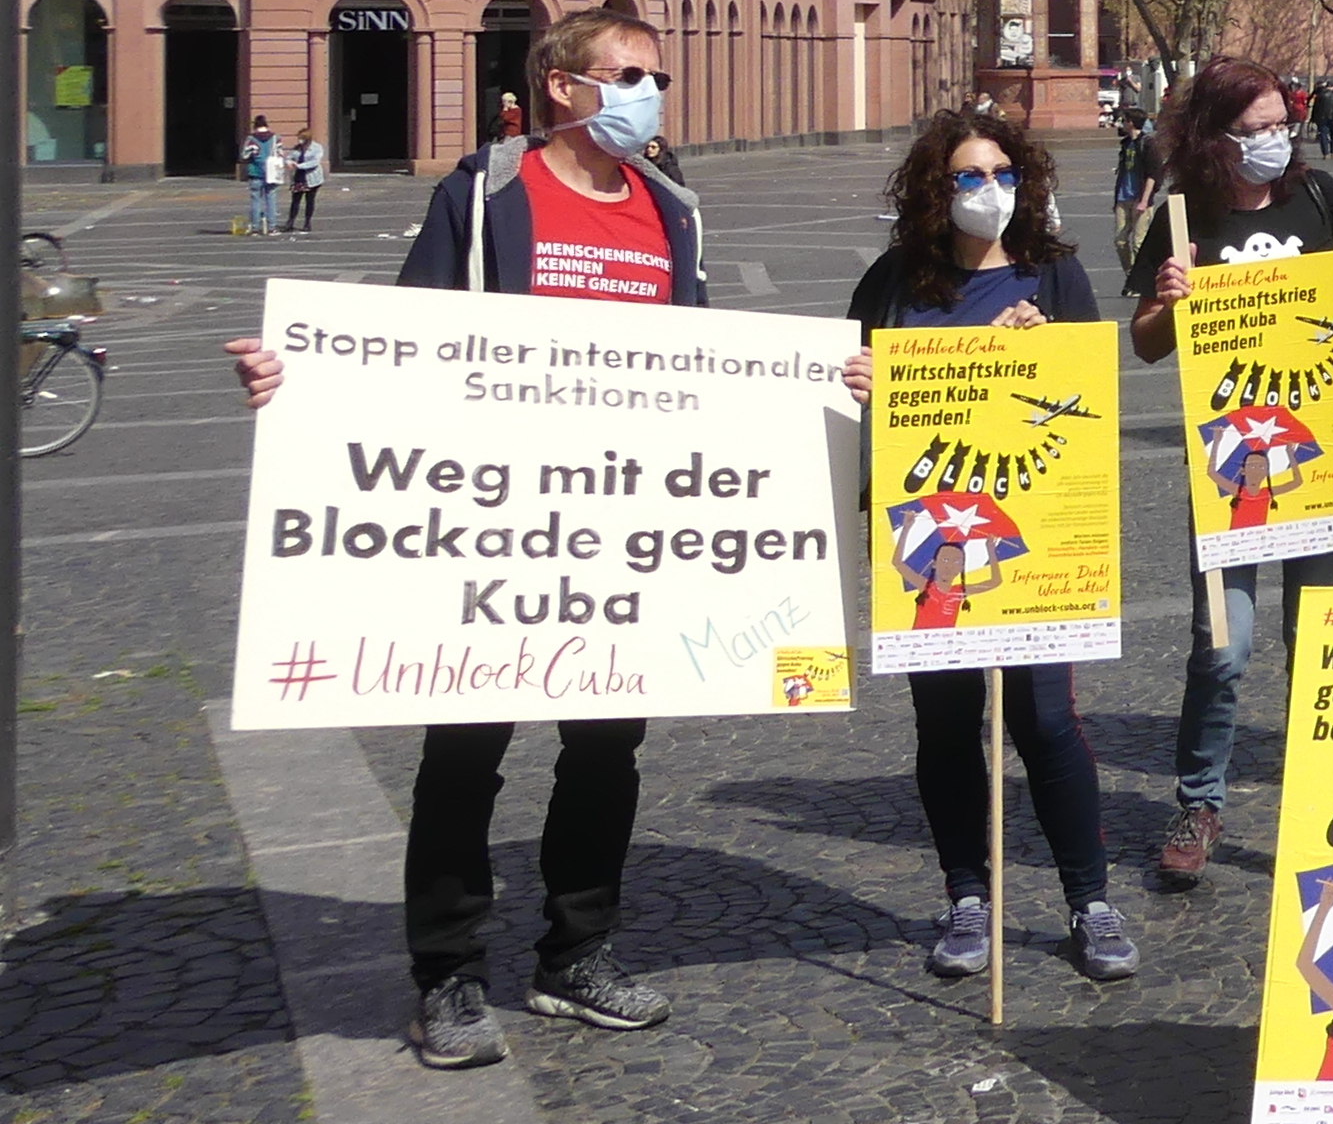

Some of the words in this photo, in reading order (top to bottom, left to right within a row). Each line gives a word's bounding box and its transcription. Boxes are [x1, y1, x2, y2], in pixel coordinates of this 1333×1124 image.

[338, 10, 409, 31] SiNN
[536, 242, 671, 272] MENSCHENRECHTE
[537, 257, 604, 275] KENNEN
[537, 273, 586, 289] KEINE
[589, 277, 658, 297] GRENZEN
[1190, 287, 1317, 315] Wirtschaftskrieg
[1191, 318, 1235, 338] gegen
[1239, 312, 1276, 329] Kuba
[284, 323, 420, 360] Stopp
[436, 336, 537, 365] aller
[550, 339, 846, 385] internationalen
[889, 336, 1007, 357] #UnblockCuba
[1193, 333, 1263, 356] beenden!
[890, 360, 1038, 382] Wirtschaftskrieg
[464, 372, 701, 413] Sanktionen
[888, 390, 941, 408] gegen
[946, 385, 989, 402] Kuba
[889, 409, 972, 428] beenden!
[346, 442, 512, 508] Weg
[539, 450, 643, 497] mit
[664, 452, 771, 499] der
[271, 506, 602, 560] Blockade
[625, 526, 828, 575] gegen
[461, 576, 641, 626] Kuba
[679, 595, 811, 683] Mainz
